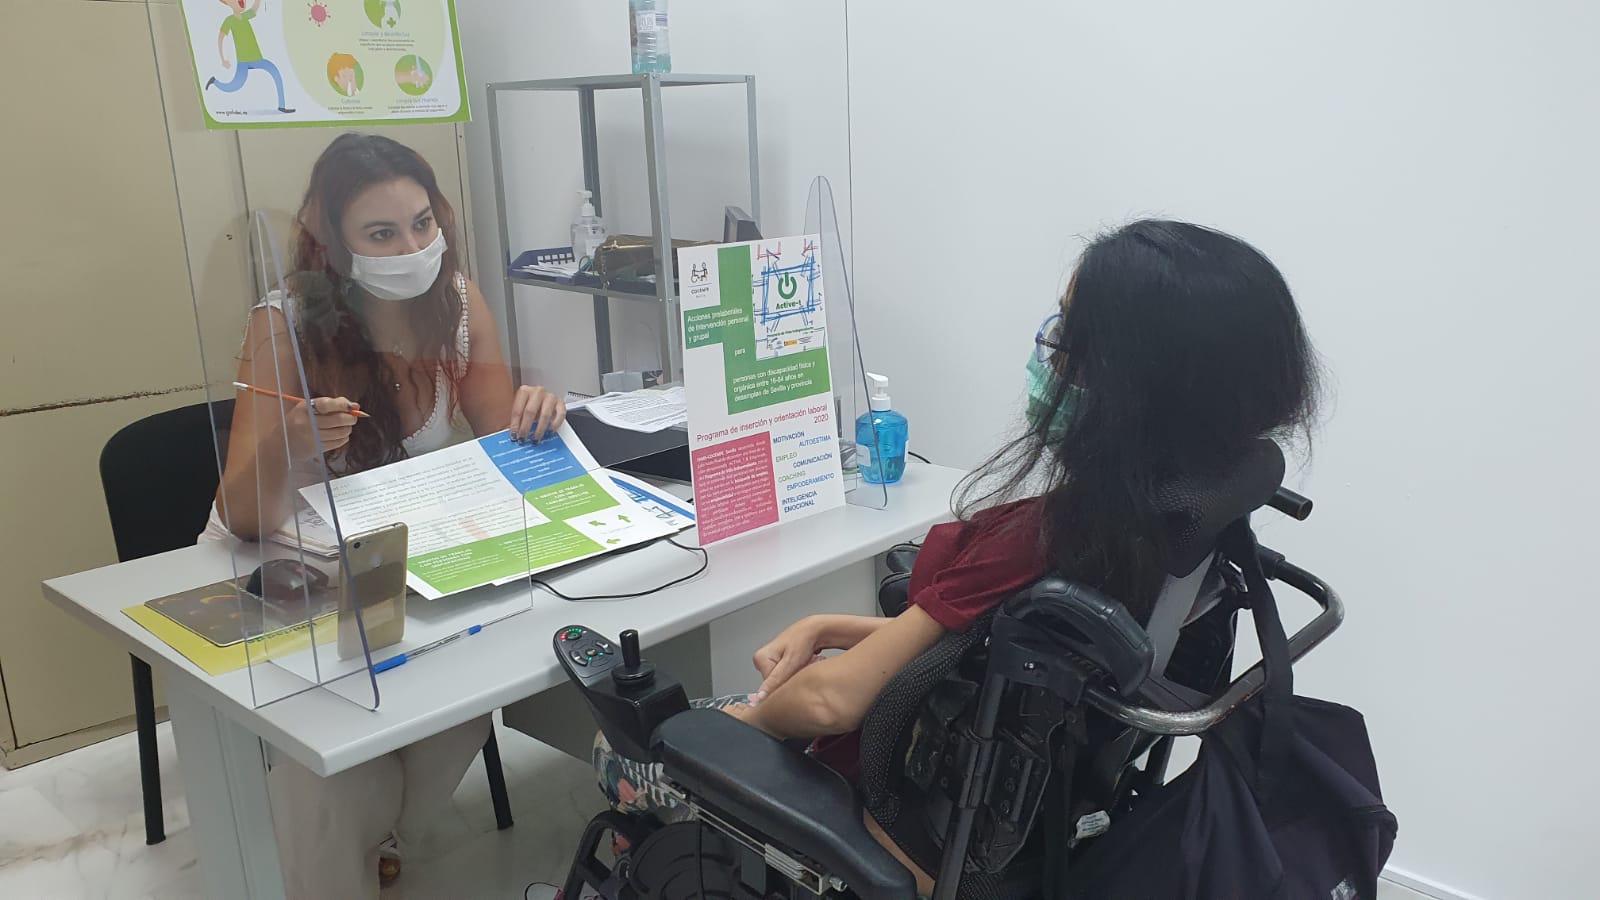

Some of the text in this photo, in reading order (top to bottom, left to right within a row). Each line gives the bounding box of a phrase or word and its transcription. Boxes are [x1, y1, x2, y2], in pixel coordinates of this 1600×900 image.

[775, 300, 802, 310] Active-t
[688, 313, 711, 322] Acciones
[728, 314, 749, 326] personal
[693, 330, 710, 343] grupal
[734, 348, 746, 357] para
[733, 374, 757, 384] personas
[767, 364, 798, 376] discapacidad
[812, 361, 816, 369] y
[733, 383, 756, 393] orgánica
[770, 384, 787, 394] Sevilla
[786, 384, 791, 392] y
[791, 380, 813, 391] provincia
[696, 404, 828, 442] Programa de inserción y orientación laboral
[814, 413, 829, 424] 2020
[799, 434, 831, 447] AUTOESTIMA
[775, 452, 798, 463] EMPLEO
[778, 470, 806, 483] COACHING
[786, 472, 835, 491] EMPODERAMIENTO
[782, 490, 817, 505] INTELIGENCIA
[784, 499, 815, 513] EMOCIONAL
